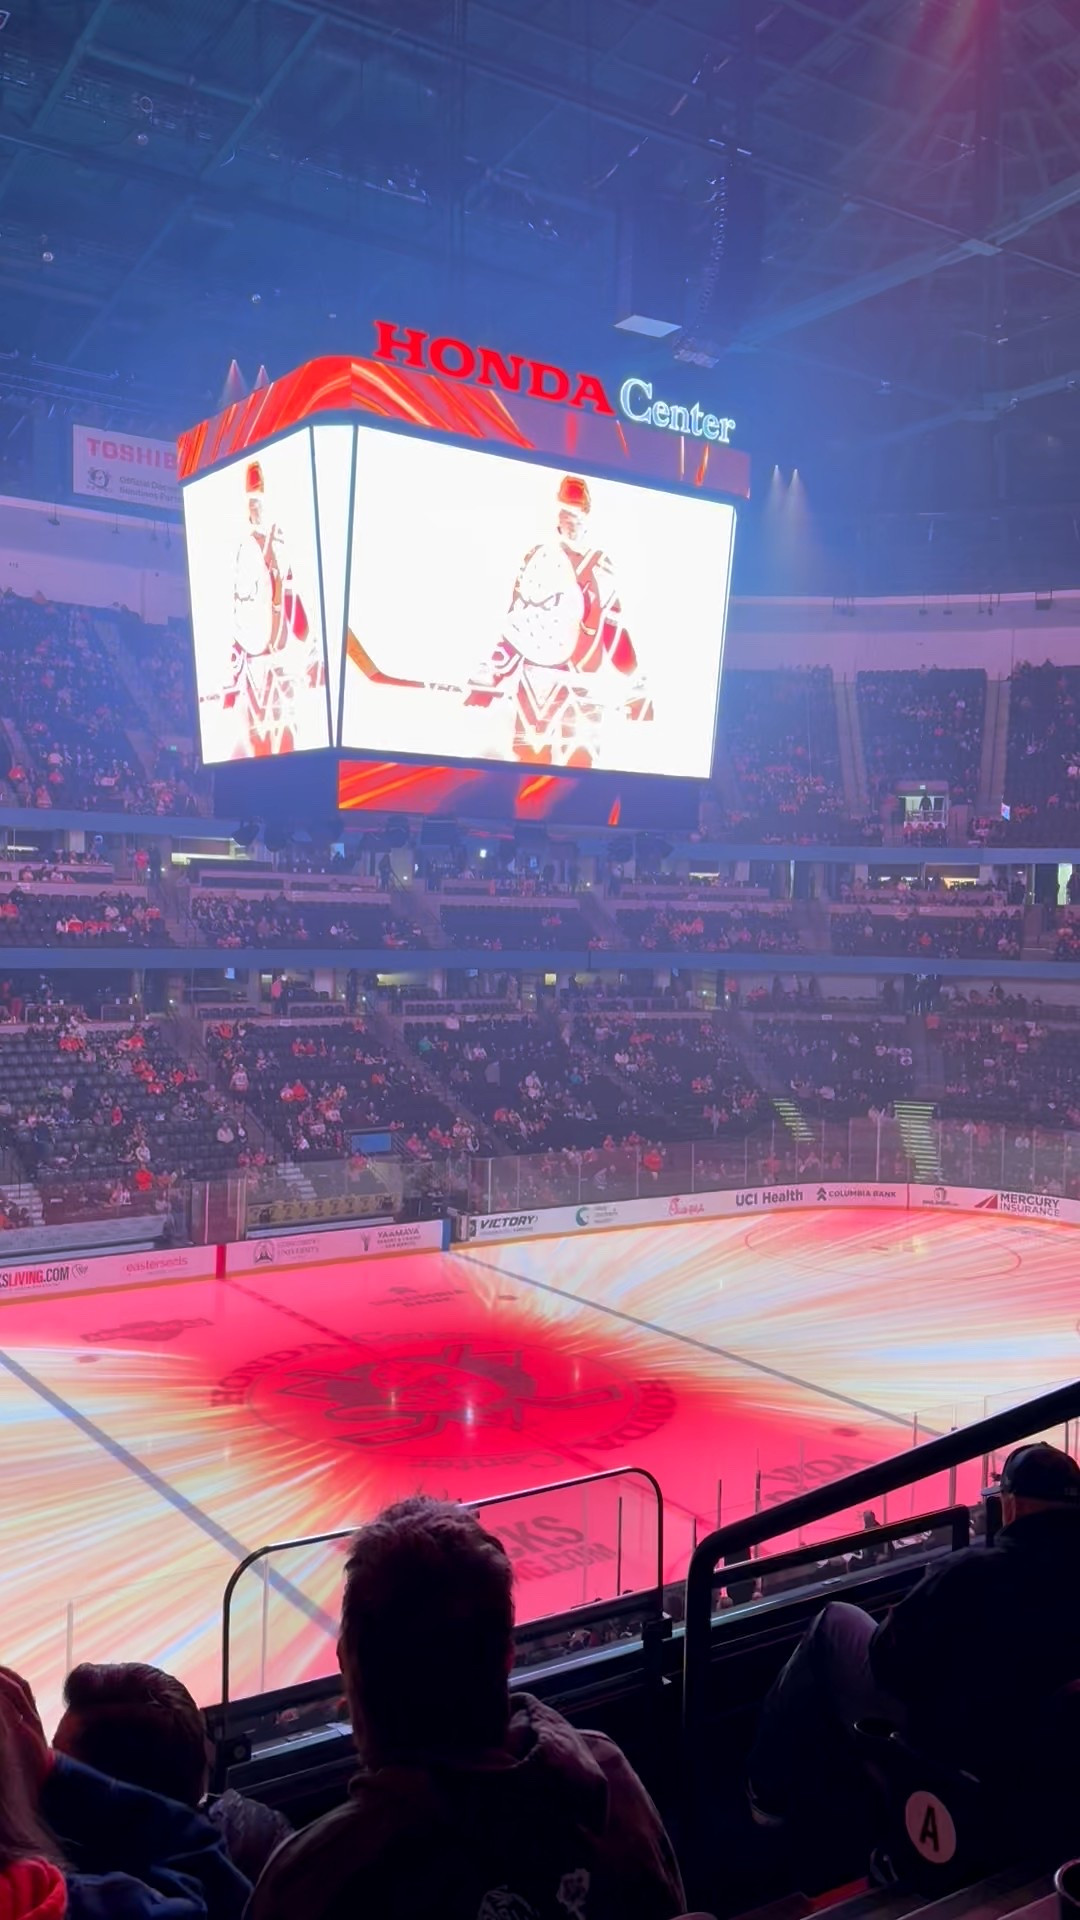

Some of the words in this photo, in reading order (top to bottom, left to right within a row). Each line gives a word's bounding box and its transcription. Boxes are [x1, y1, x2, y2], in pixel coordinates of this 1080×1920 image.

[373, 320, 615, 416] HONDA
[619, 377, 736, 444] Center
[87, 437, 178, 470] TOSHIB
[735, 1193, 758, 1207] UCI
[762, 1189, 804, 1205] Health
[828, 1189, 871, 1198] COLUMBIA
[872, 1190, 897, 1199] BANK
[1000, 1193, 1060, 1209] MERCURY
[1000, 1202, 1060, 1217] INSURANCE
[480, 1214, 535, 1230] VICTORY
[919, 1803, 941, 1853] A
